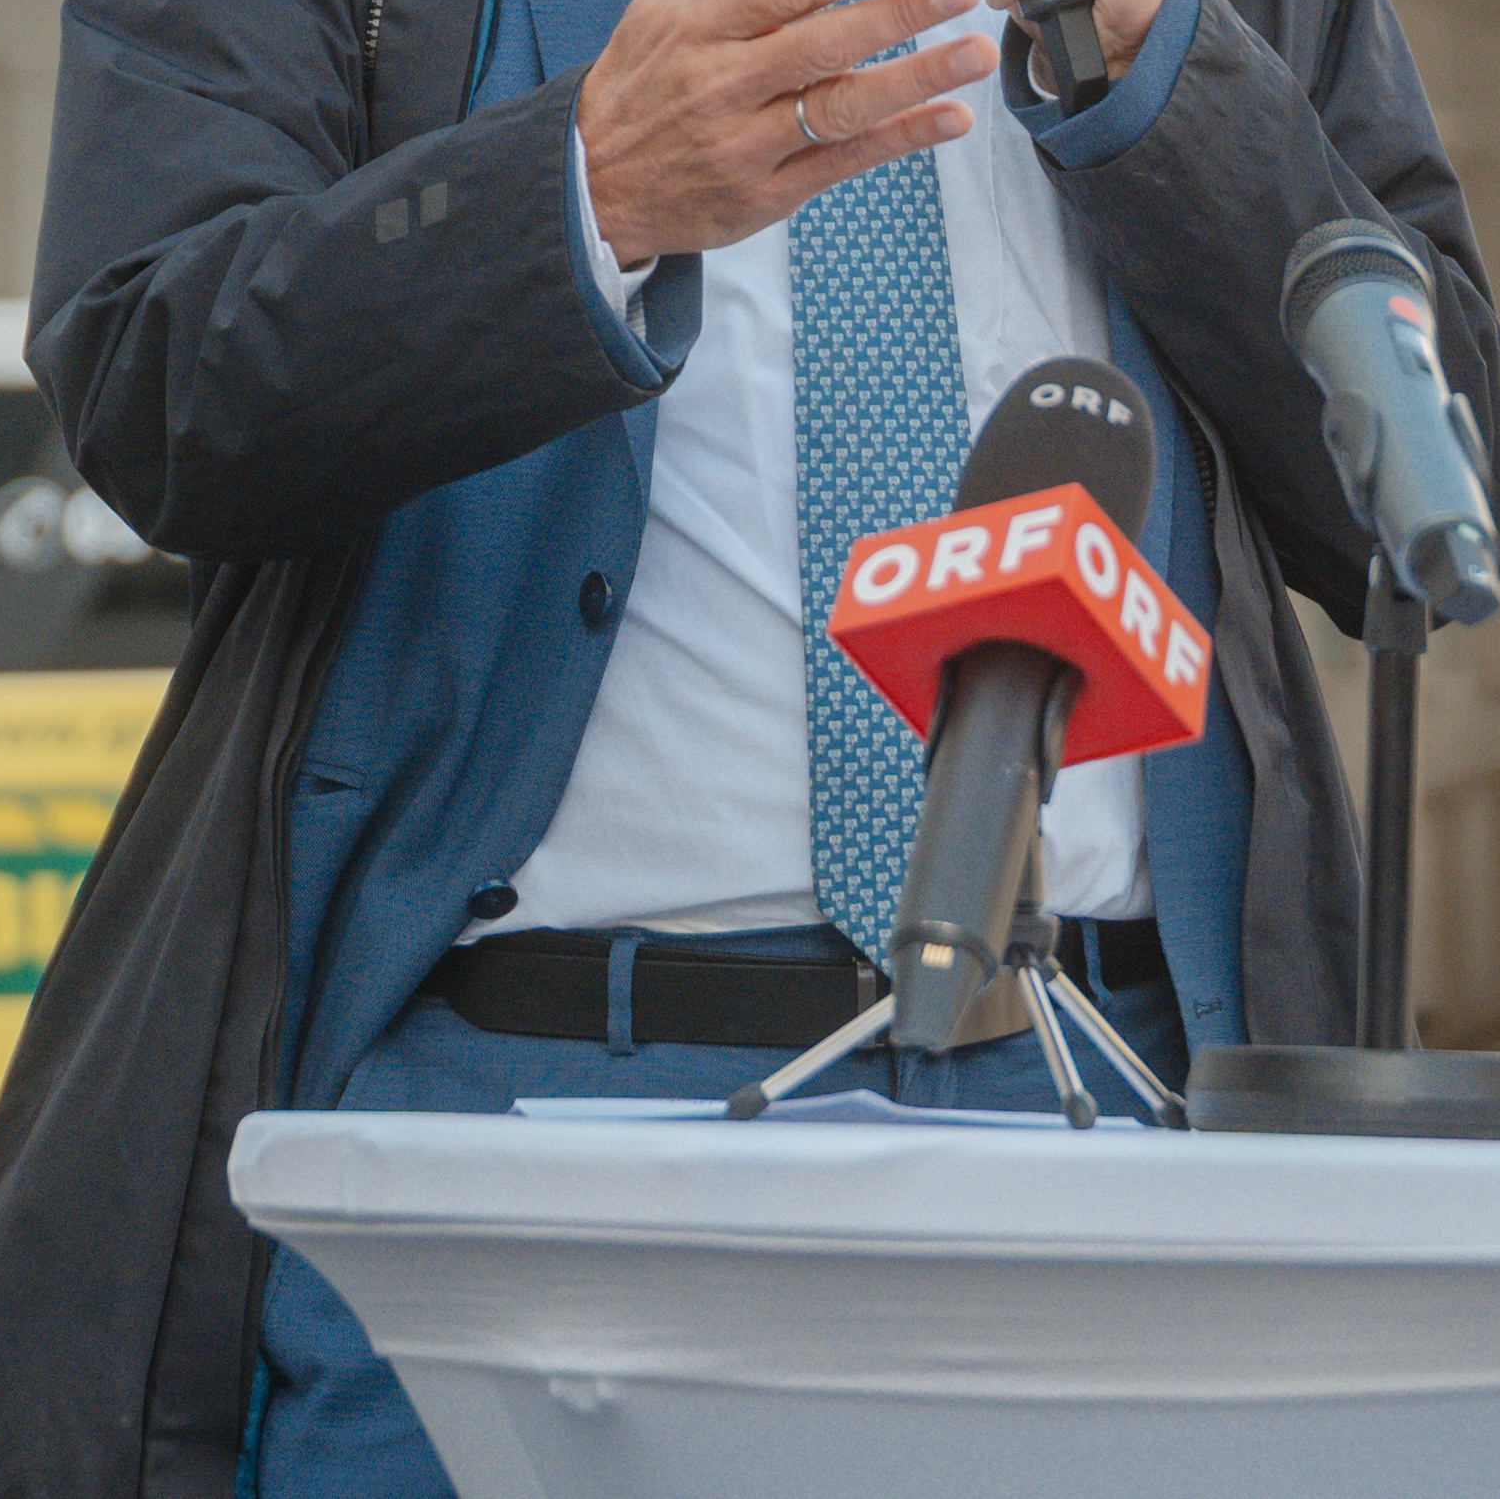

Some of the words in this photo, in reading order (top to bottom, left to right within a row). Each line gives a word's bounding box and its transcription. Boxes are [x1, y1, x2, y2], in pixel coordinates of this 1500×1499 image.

[1029, 382, 1134, 425] ORF
[851, 504, 1063, 606] ORF
[1074, 521, 1204, 687] ORF
